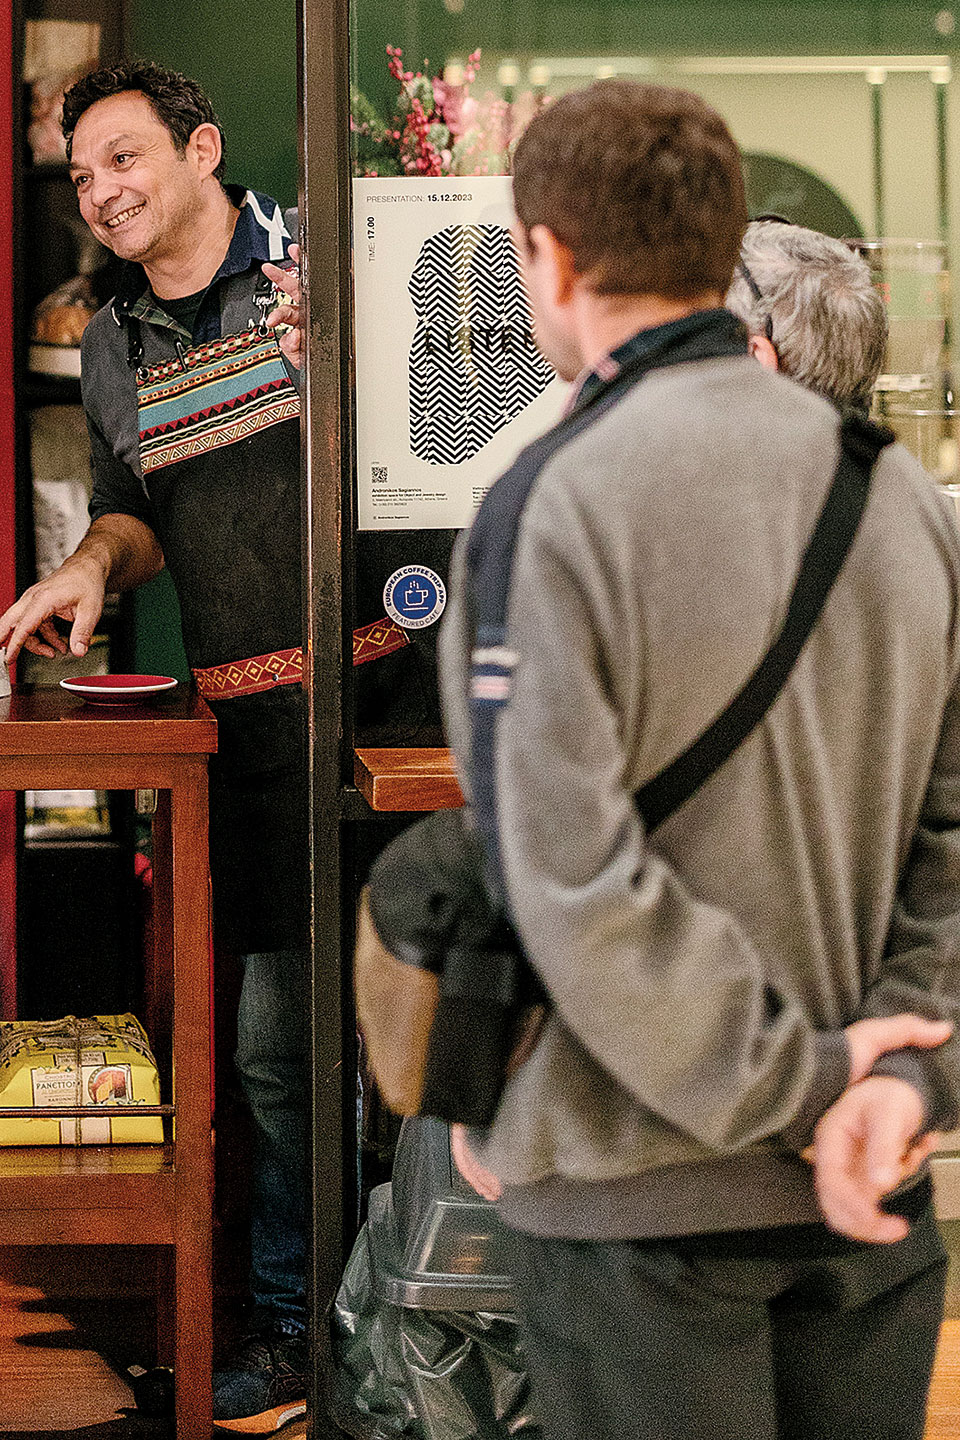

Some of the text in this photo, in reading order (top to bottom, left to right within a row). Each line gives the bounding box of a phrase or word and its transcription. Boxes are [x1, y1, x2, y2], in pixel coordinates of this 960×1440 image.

[366, 193, 473, 203] PRESENTATION: 15.12.2023
[366, 216, 377, 263] TIME: 17.00
[385, 571, 403, 607] EUROPEAN
[403, 567, 430, 576] COFFEE
[429, 572, 442, 588] TRIP
[391, 612, 425, 627] FEATURED
